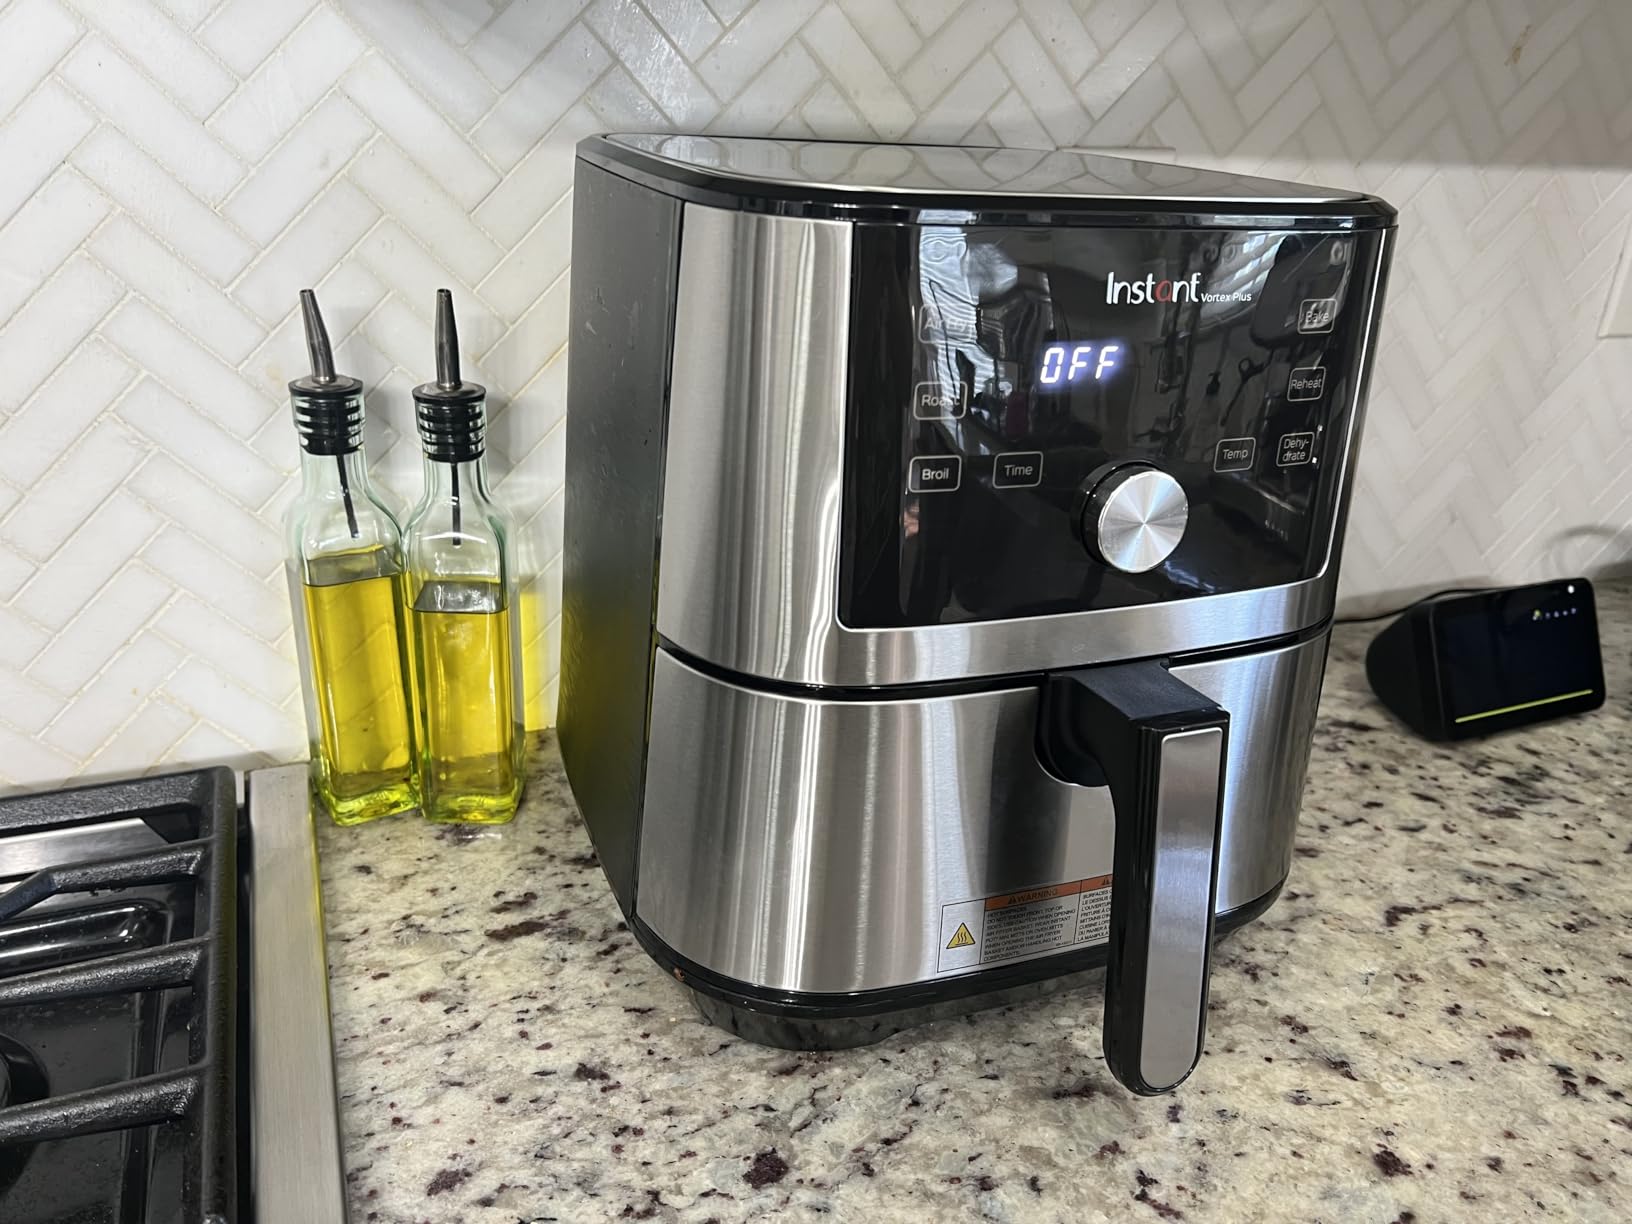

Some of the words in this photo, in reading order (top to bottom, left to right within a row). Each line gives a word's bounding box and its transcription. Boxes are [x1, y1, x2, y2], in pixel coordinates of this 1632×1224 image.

[1106, 271, 1201, 305] Instant
[1201, 292, 1231, 303] Vortex
[1232, 292, 1252, 302] Plus
[1305, 310, 1329, 323] Bake
[1040, 345, 1119, 384] OFF
[1290, 377, 1322, 390] Reheat
[921, 394, 960, 408] Roat
[1283, 438, 1310, 451] Dehy-
[1223, 448, 1250, 462] Temp
[1282, 450, 1306, 463] drate
[921, 467, 950, 481] Broil
[1004, 464, 1033, 478] Time
[1016, 889, 1057, 901] WARNING
